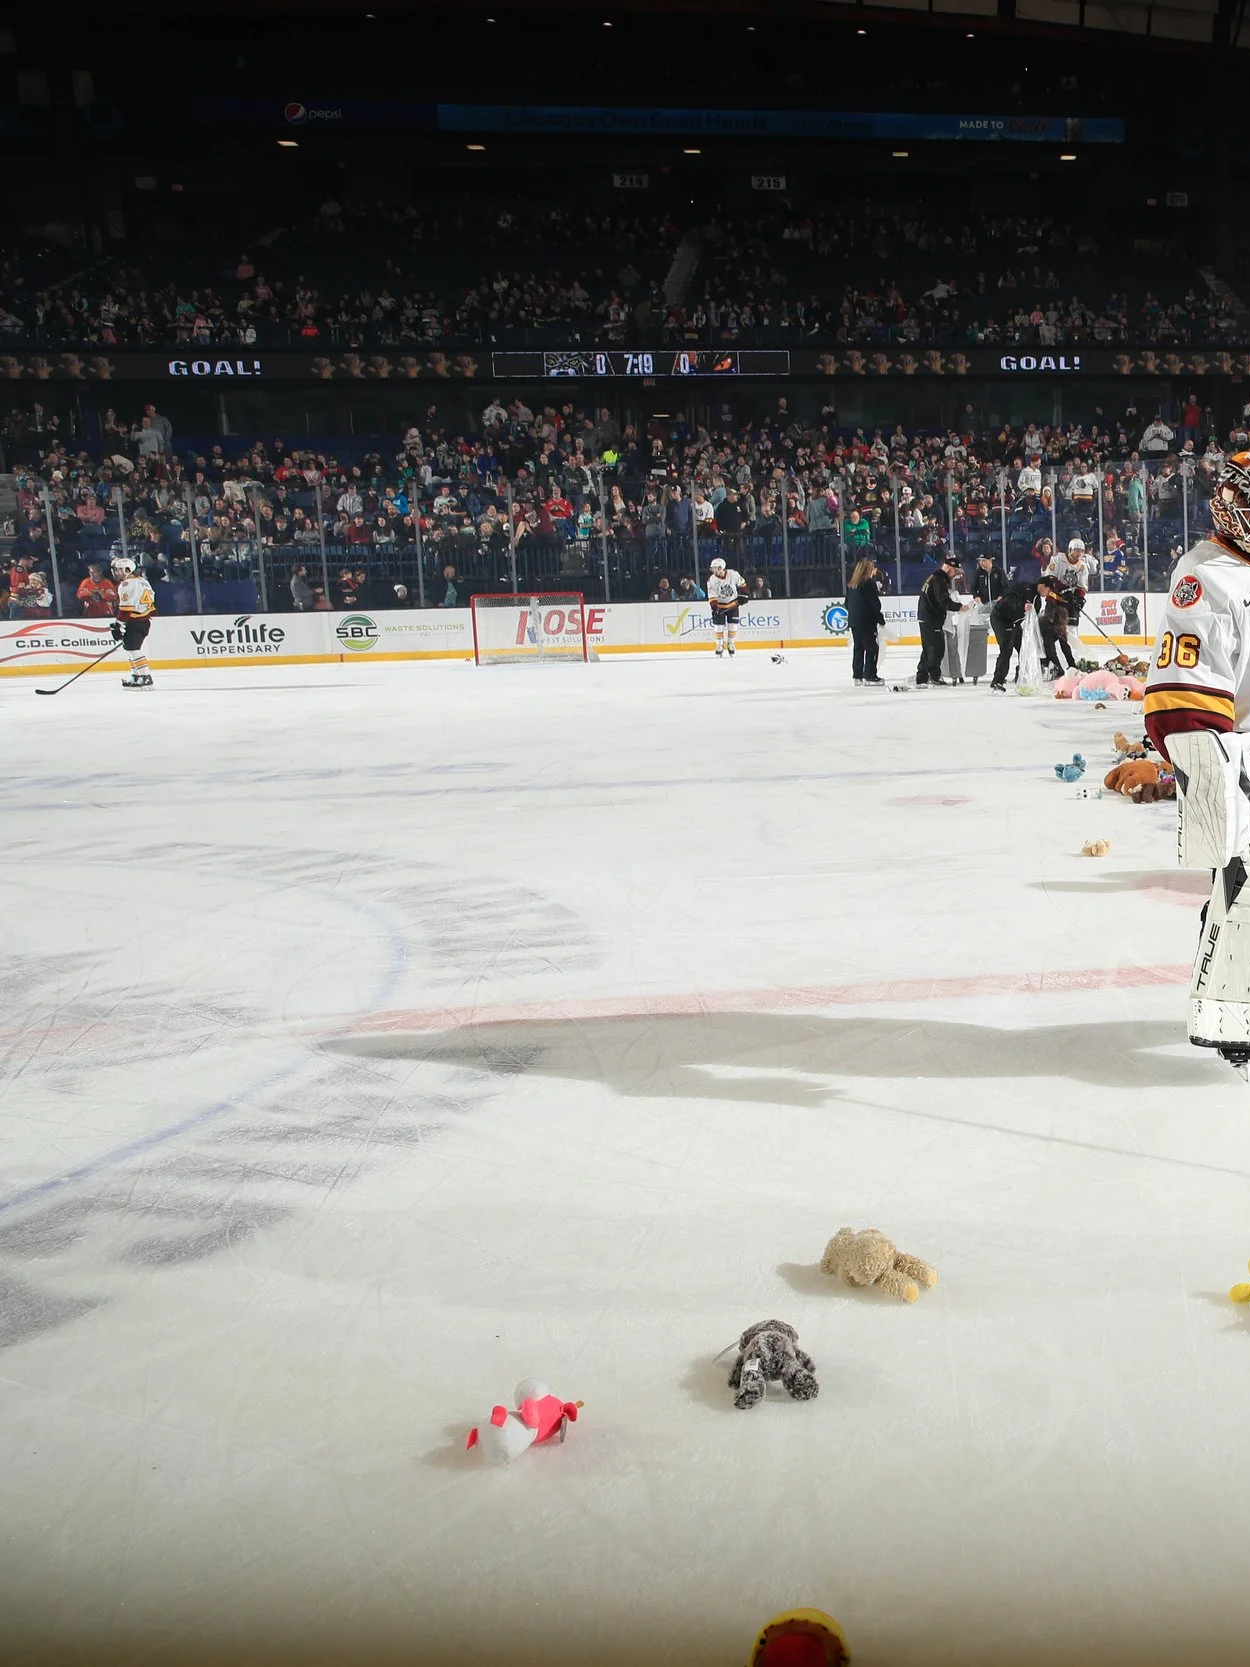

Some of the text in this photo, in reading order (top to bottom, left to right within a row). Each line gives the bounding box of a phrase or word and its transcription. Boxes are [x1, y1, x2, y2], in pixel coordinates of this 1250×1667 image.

[308, 108, 343, 121] pepsi
[959, 119, 989, 129] MADE
[990, 119, 1004, 129] TO
[168, 360, 261, 376] GOAL!
[624, 354, 653, 374] 7:19
[1000, 356, 1080, 370] GOAL!
[190, 623, 285, 645] verilife
[336, 626, 381, 638] S.B.C.
[16, 637, 117, 648] C.D.E. Collision
[197, 645, 280, 655] DISPENSARY
[1156, 630, 1201, 670] 36
[1196, 923, 1221, 992] TRUE
